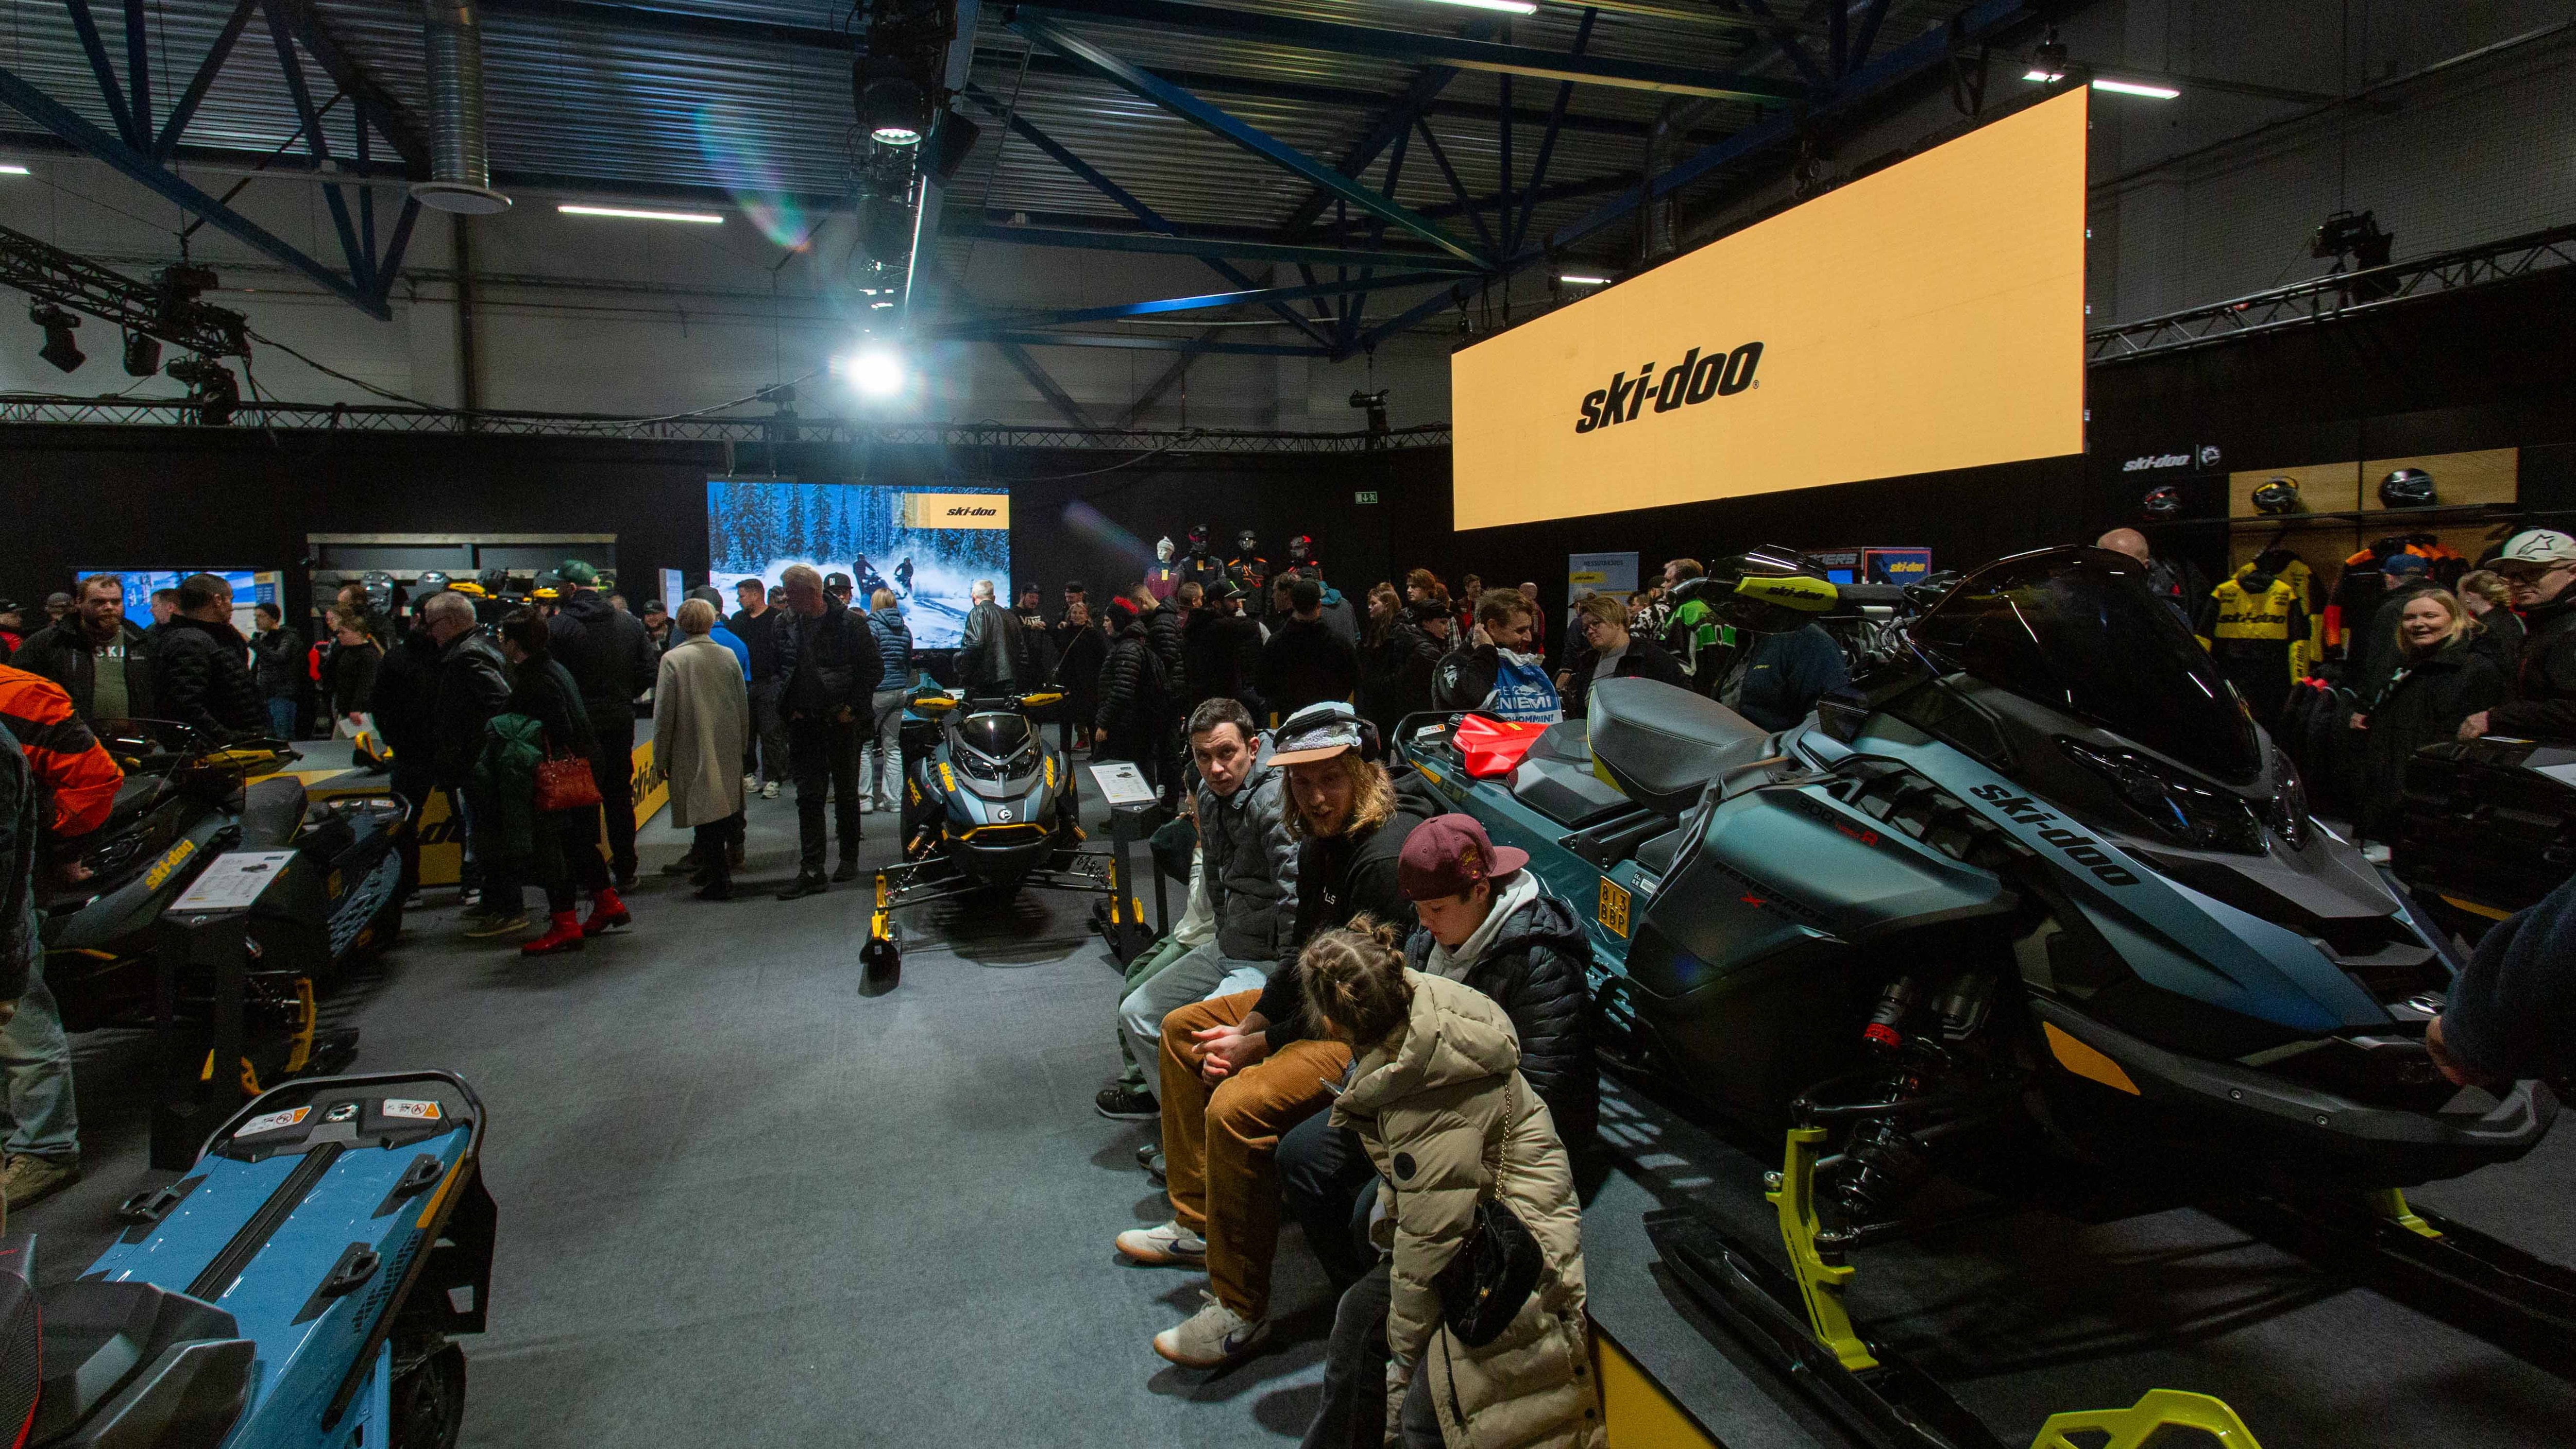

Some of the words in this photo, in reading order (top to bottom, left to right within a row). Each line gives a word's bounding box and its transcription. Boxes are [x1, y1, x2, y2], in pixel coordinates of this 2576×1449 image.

[1575, 342, 1764, 434] ski-doo
[2123, 454, 2191, 471] ski-doo
[946, 507, 997, 517] ski-doo
[1969, 784, 2141, 886] ski-doo
[145, 839, 195, 890] ski-doo
[1602, 884, 1627, 912] 813
[1601, 902, 1625, 929] BBP
